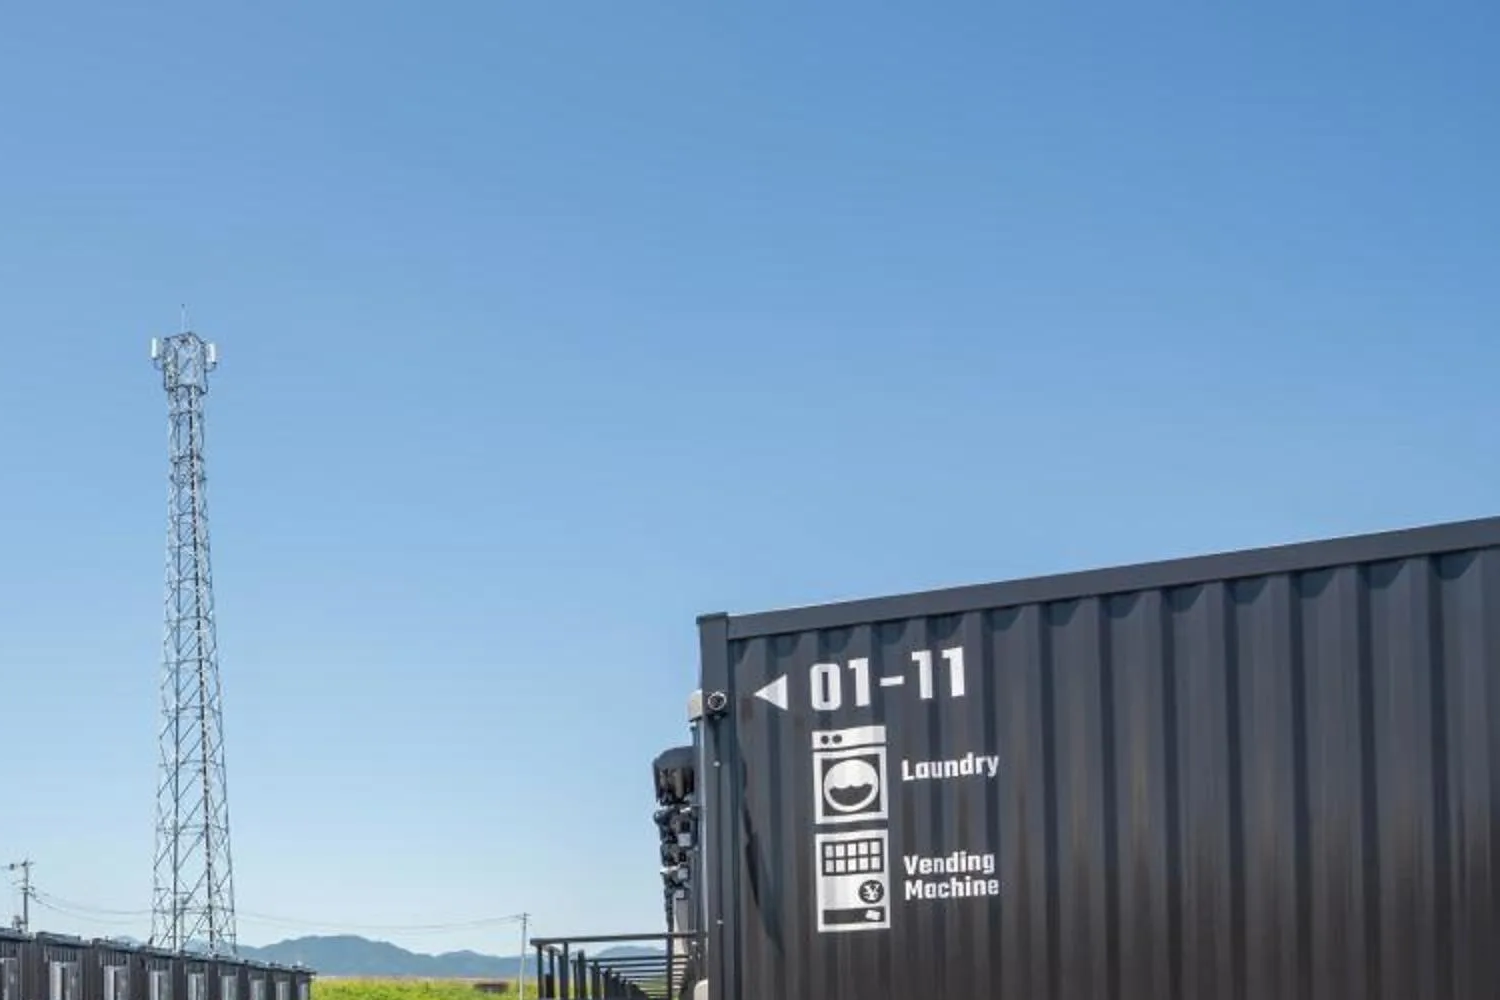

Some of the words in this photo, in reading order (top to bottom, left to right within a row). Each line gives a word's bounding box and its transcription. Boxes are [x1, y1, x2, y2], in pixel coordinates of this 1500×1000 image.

[809, 646, 967, 711] 01-11
[902, 752, 1000, 781] Laundry
[903, 852, 996, 876] Vending
[904, 876, 1000, 900] Machine
